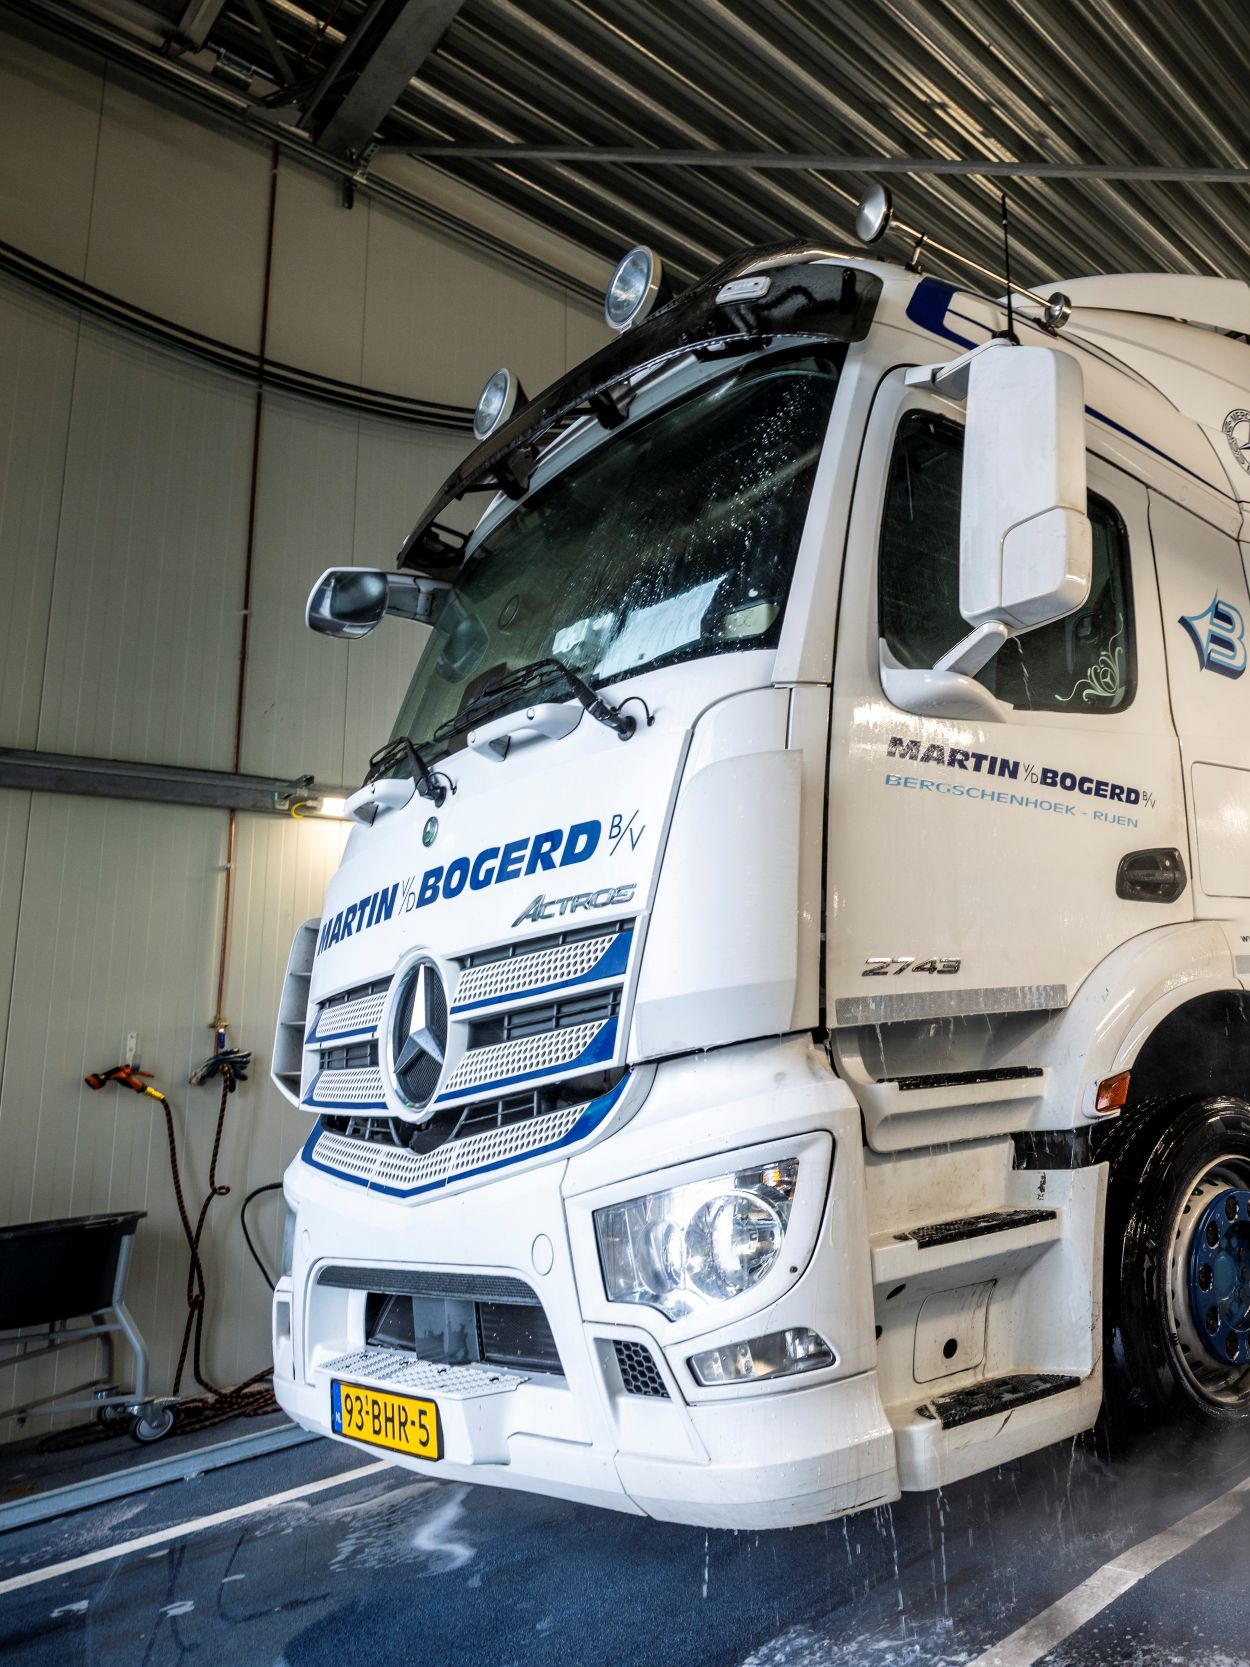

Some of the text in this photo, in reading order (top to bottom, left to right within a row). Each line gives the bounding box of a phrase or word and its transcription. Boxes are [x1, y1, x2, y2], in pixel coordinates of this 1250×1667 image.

[886, 736, 1156, 809] MARTIN V/D BOGERD B/V
[884, 773, 1077, 817] BERGSCHENHOEK
[1093, 810, 1139, 829] RIJEN
[317, 809, 646, 956] MARTIN V/D BOGERD B/V
[861, 956, 962, 977] 2743
[344, 1392, 430, 1448] 93-BHR-5
